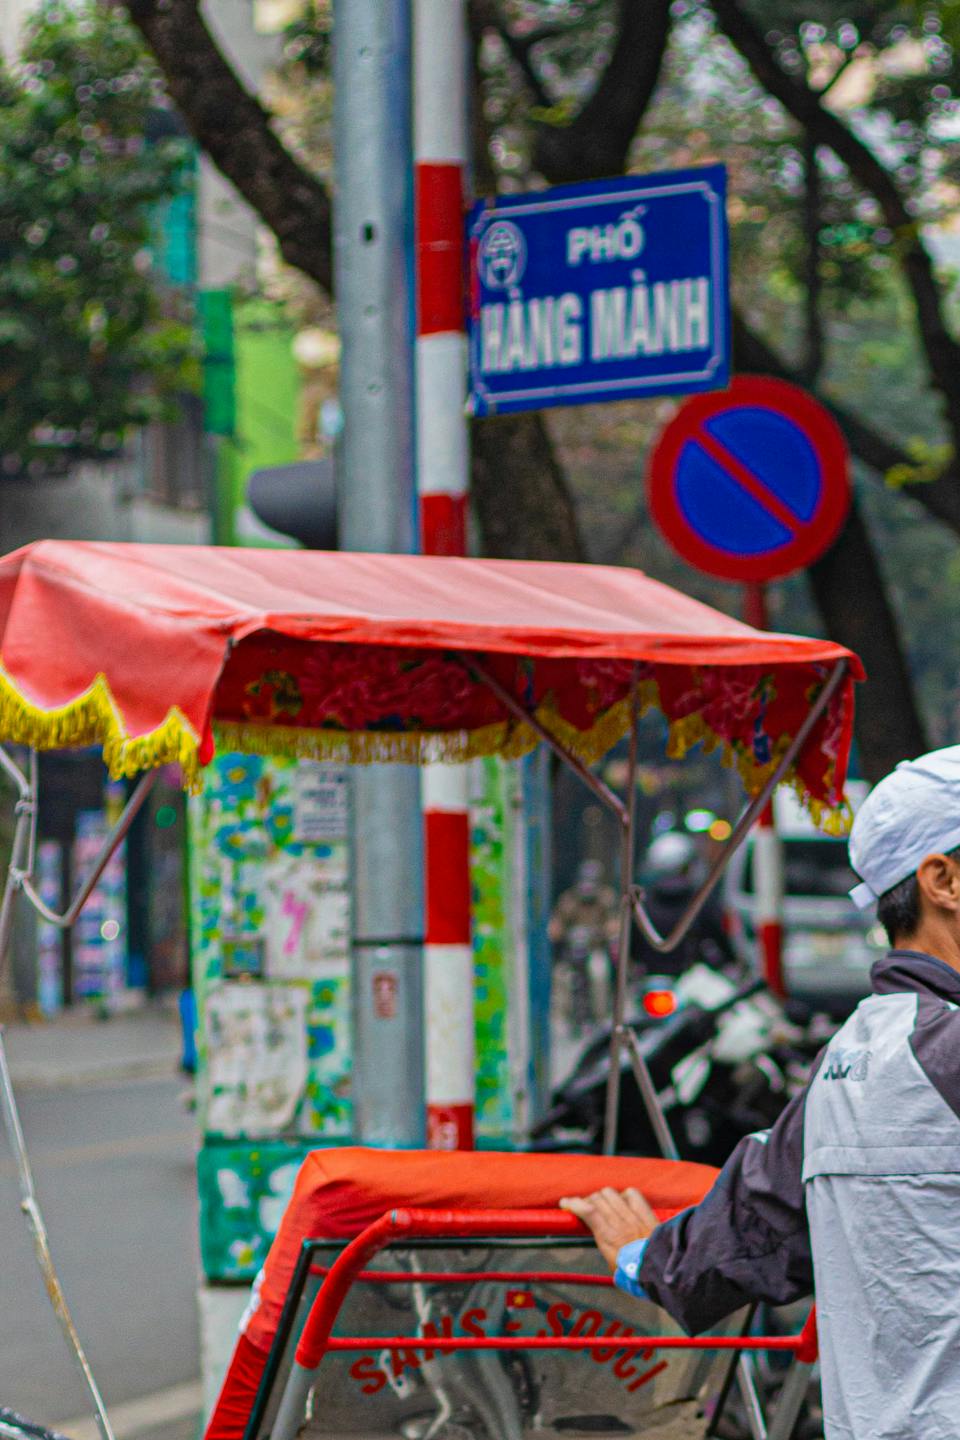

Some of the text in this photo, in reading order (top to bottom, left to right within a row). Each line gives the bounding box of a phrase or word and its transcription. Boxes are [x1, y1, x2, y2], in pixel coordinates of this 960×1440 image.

[567, 204, 647, 264] PHỐ
[481, 268, 709, 373] HÀNG MÀNH
